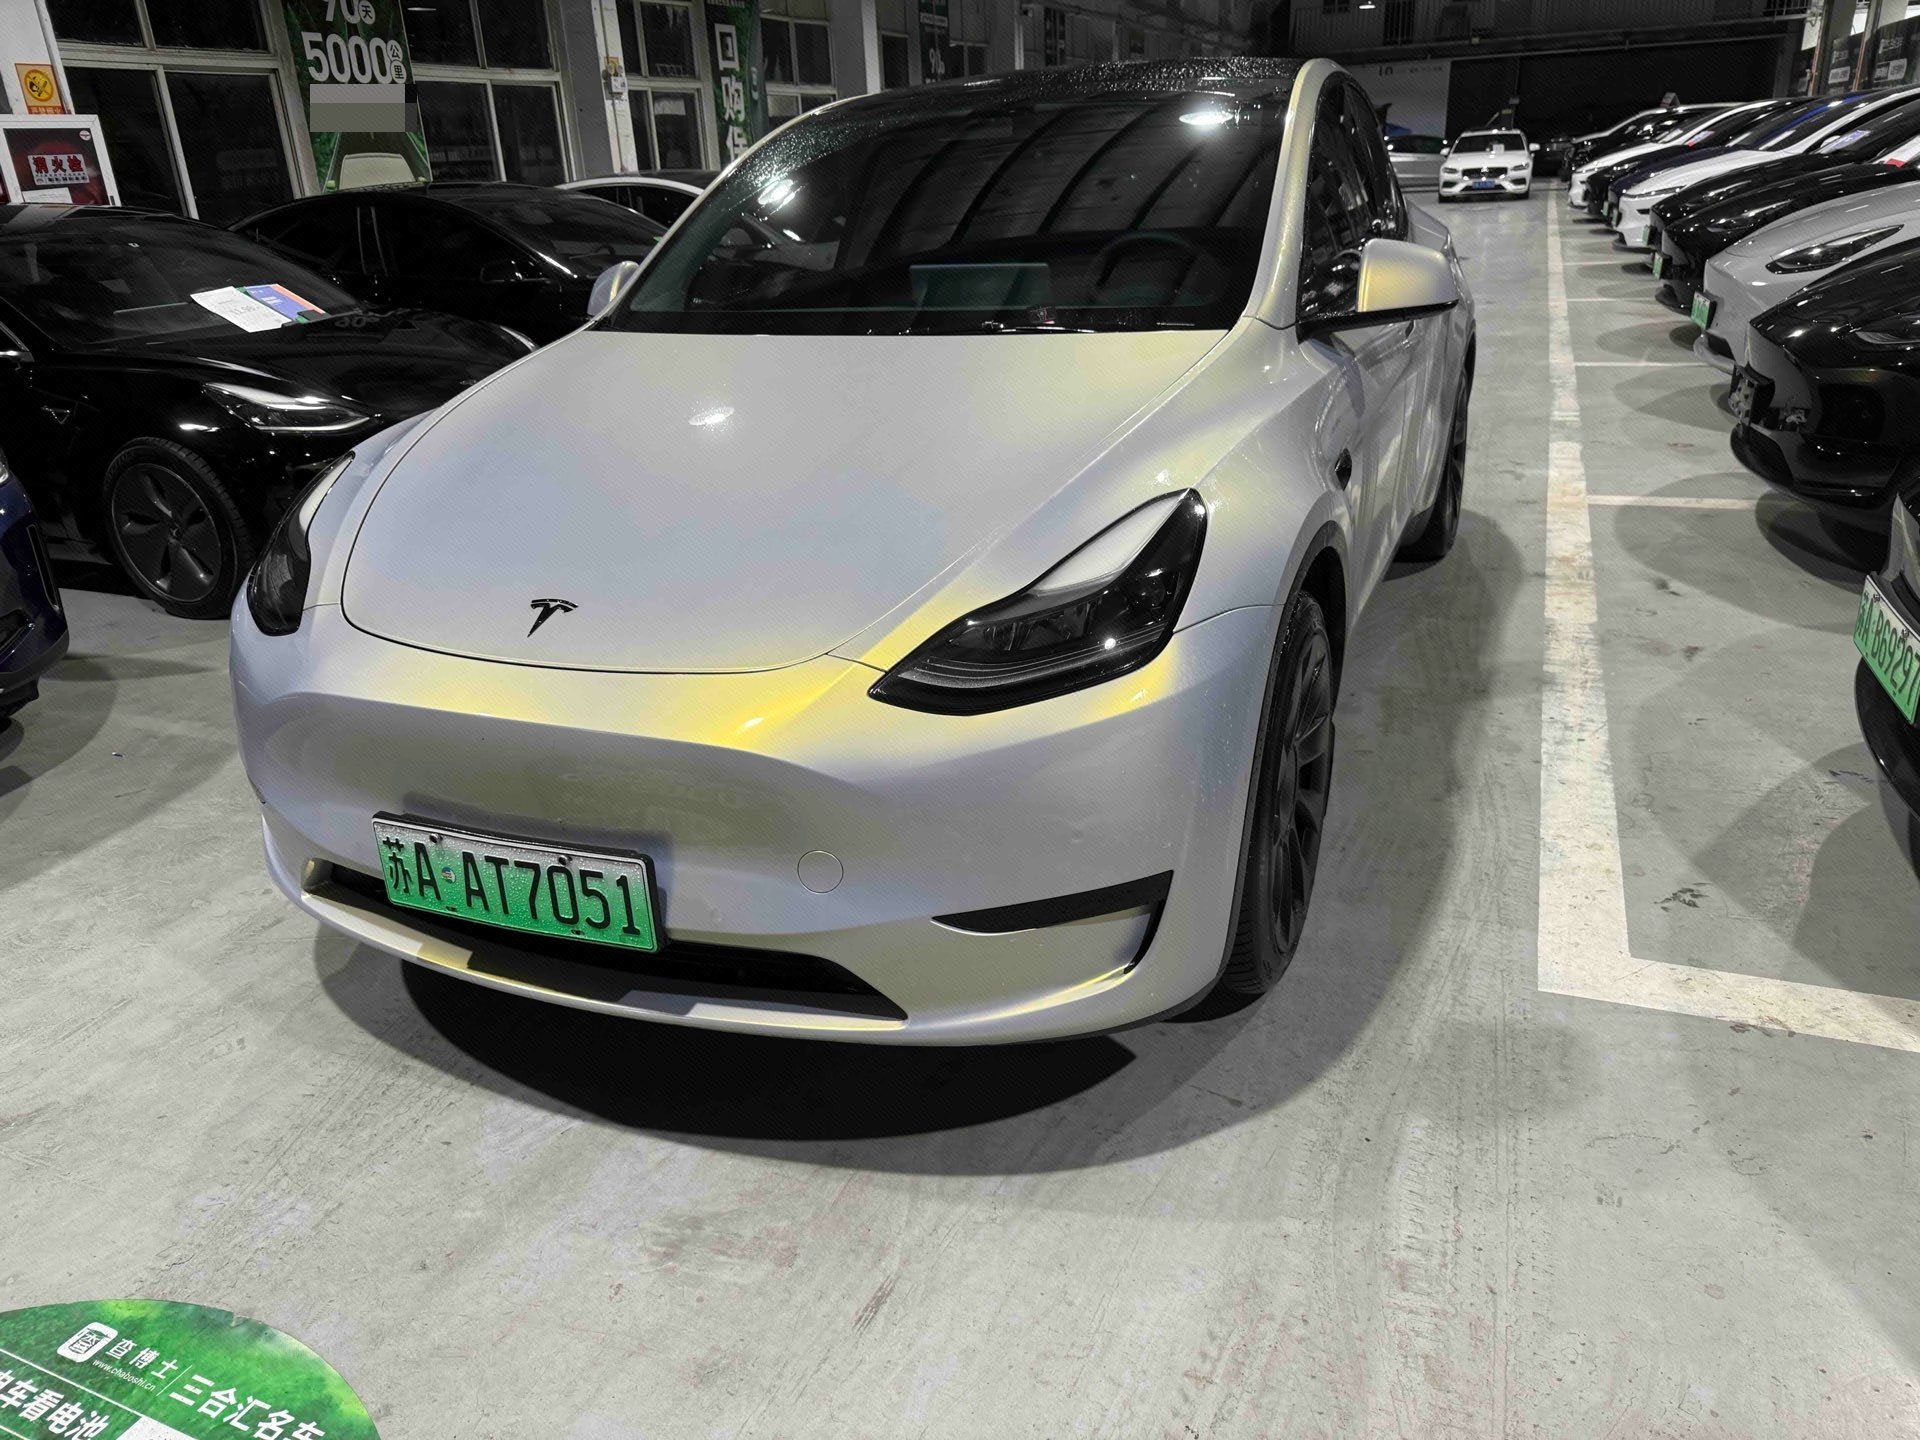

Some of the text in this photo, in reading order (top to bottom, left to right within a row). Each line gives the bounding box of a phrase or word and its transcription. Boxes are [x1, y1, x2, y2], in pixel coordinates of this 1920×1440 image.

[92, 1358, 156, 1392] www.chaboshi.cn
[105, 1338, 178, 1380] 查博士
